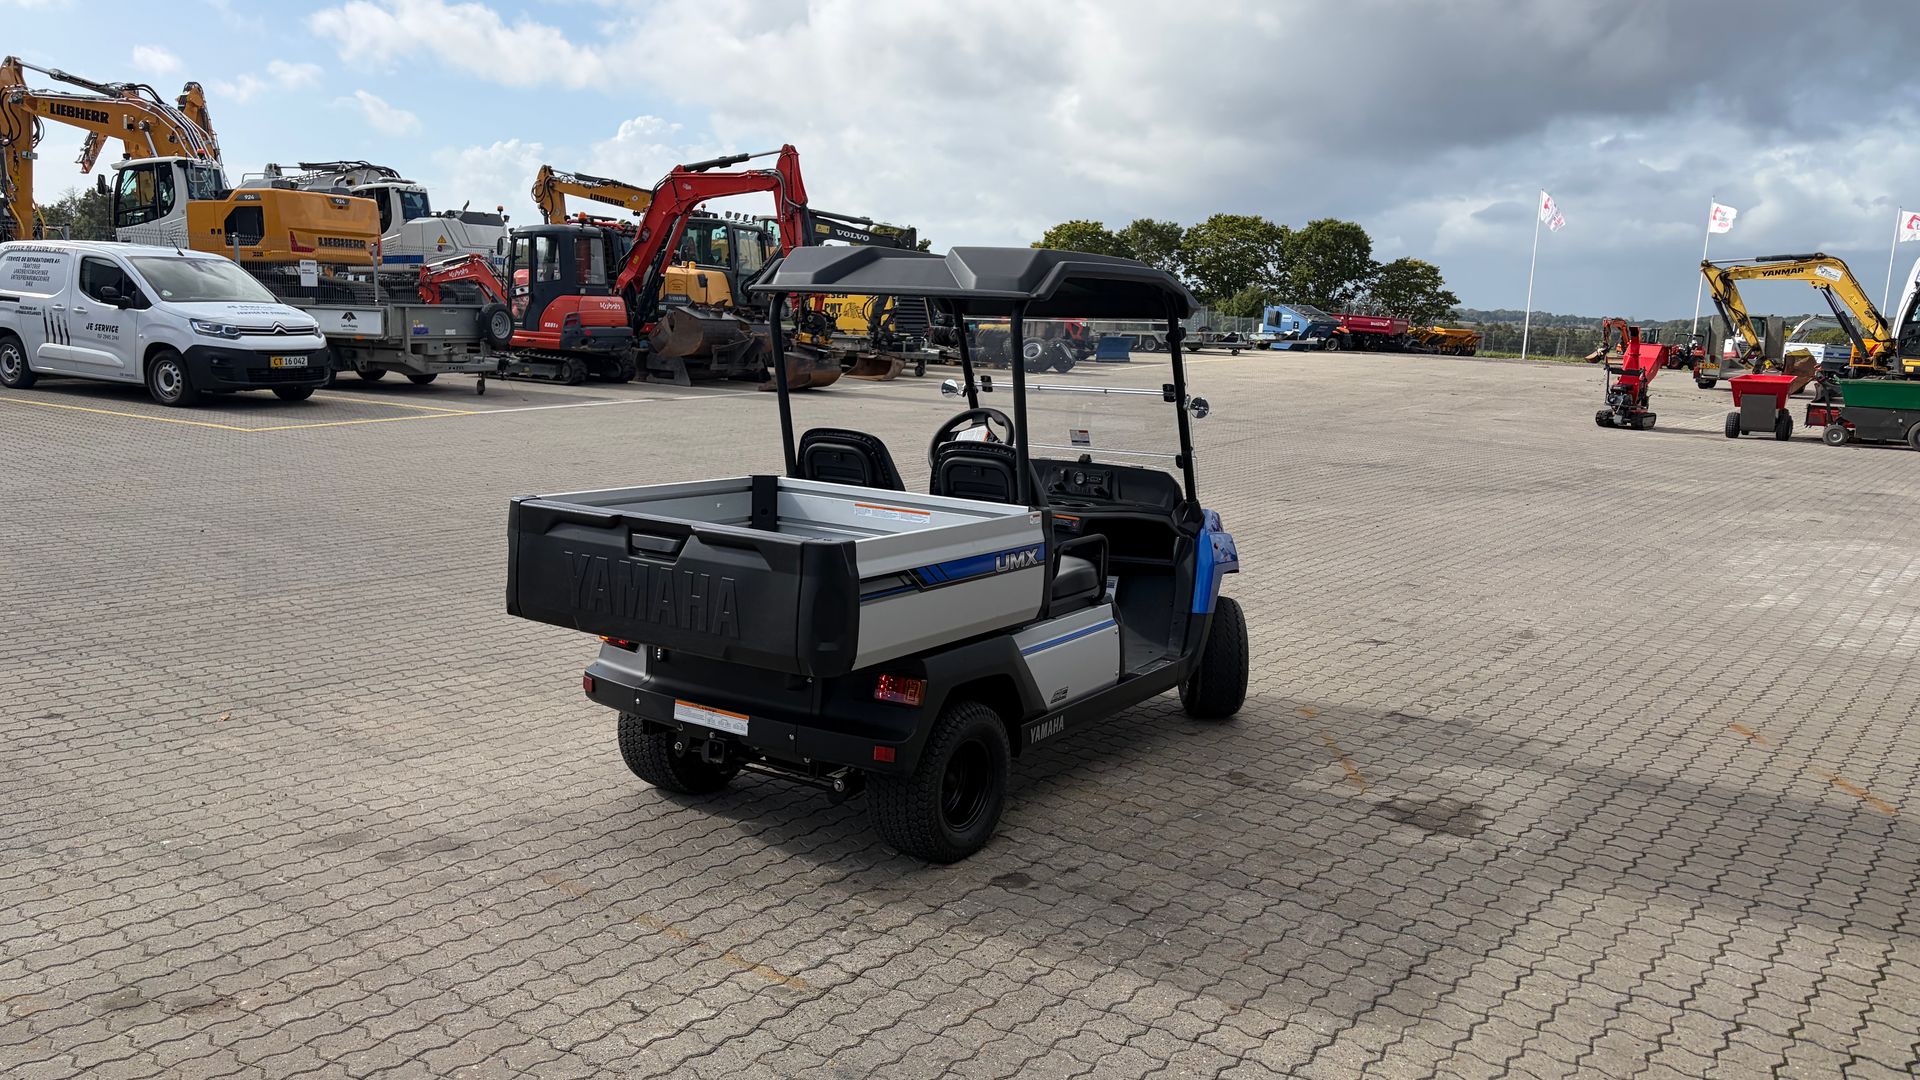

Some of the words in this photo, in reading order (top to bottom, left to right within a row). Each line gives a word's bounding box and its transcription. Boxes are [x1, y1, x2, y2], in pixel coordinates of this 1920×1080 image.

[50, 103, 109, 124] LIEBHERR
[590, 193, 625, 207] LIEBHERR
[836, 229, 870, 241] VOLVO
[318, 237, 366, 249] LIEBHERR
[449, 268, 469, 278] Kubota
[1762, 267, 1805, 277] YANMAR
[600, 302, 621, 310] Kubota
[825, 303, 842, 312] PMT
[86, 323, 94, 331] JE
[94, 323, 120, 334] SERVICE
[273, 358, 283, 366] CT
[285, 358, 293, 366] 16
[293, 357, 306, 366] 042
[995, 548, 1038, 573] UMX
[564, 550, 741, 641] YAMAHA
[1030, 715, 1064, 744] YAMAHA
